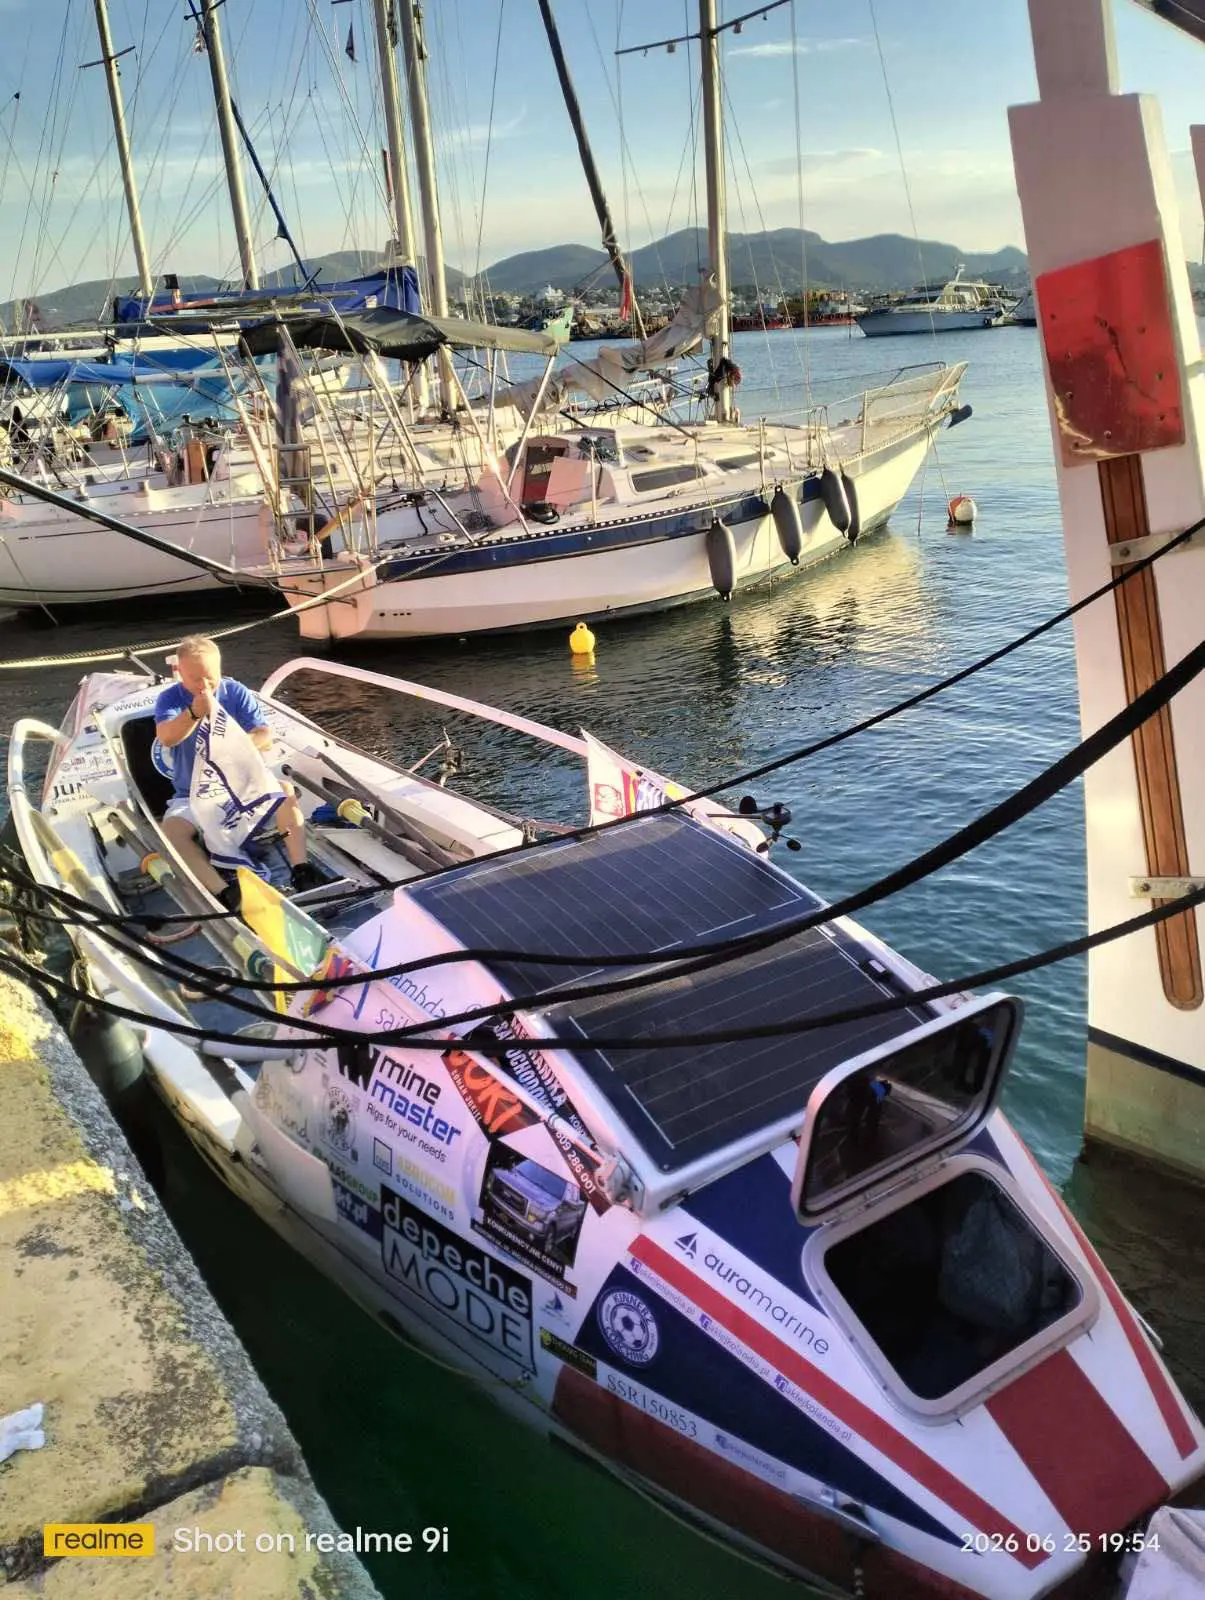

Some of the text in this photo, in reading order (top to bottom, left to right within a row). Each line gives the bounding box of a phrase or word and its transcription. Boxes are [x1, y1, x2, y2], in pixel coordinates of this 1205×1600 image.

[379, 1055, 441, 1105] mine
[366, 1102, 447, 1162] Rigs for your needs
[371, 1079, 462, 1145] master
[395, 1173, 455, 1221] SOLUTIONS
[567, 1149, 584, 1172] 286
[580, 1172, 596, 1195] 001
[383, 1197, 530, 1314] depeche
[390, 1237, 524, 1358] MODE
[704, 1253, 829, 1355] auramarine
[607, 1375, 697, 1438] SSR150853
